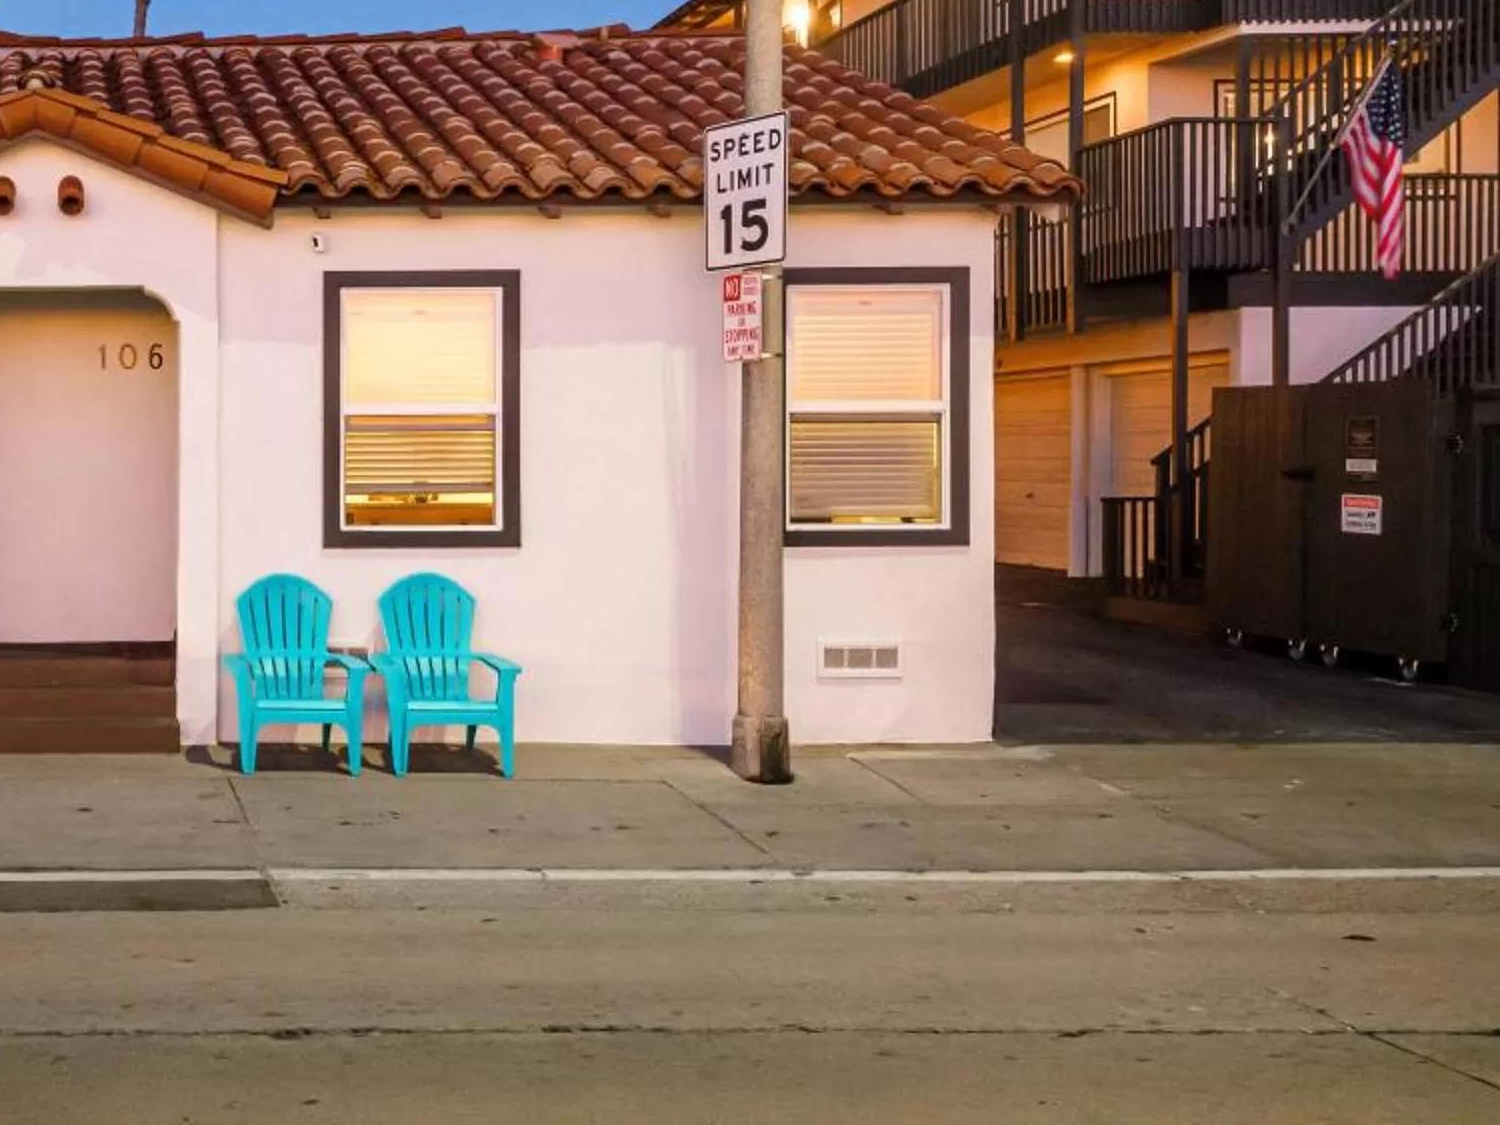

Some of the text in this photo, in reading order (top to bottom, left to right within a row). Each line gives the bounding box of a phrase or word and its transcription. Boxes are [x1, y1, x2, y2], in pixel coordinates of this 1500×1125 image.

[710, 129, 781, 162] SPEED
[717, 163, 774, 193] LIMIT
[720, 198, 769, 254] 15
[98, 343, 164, 371] 106
